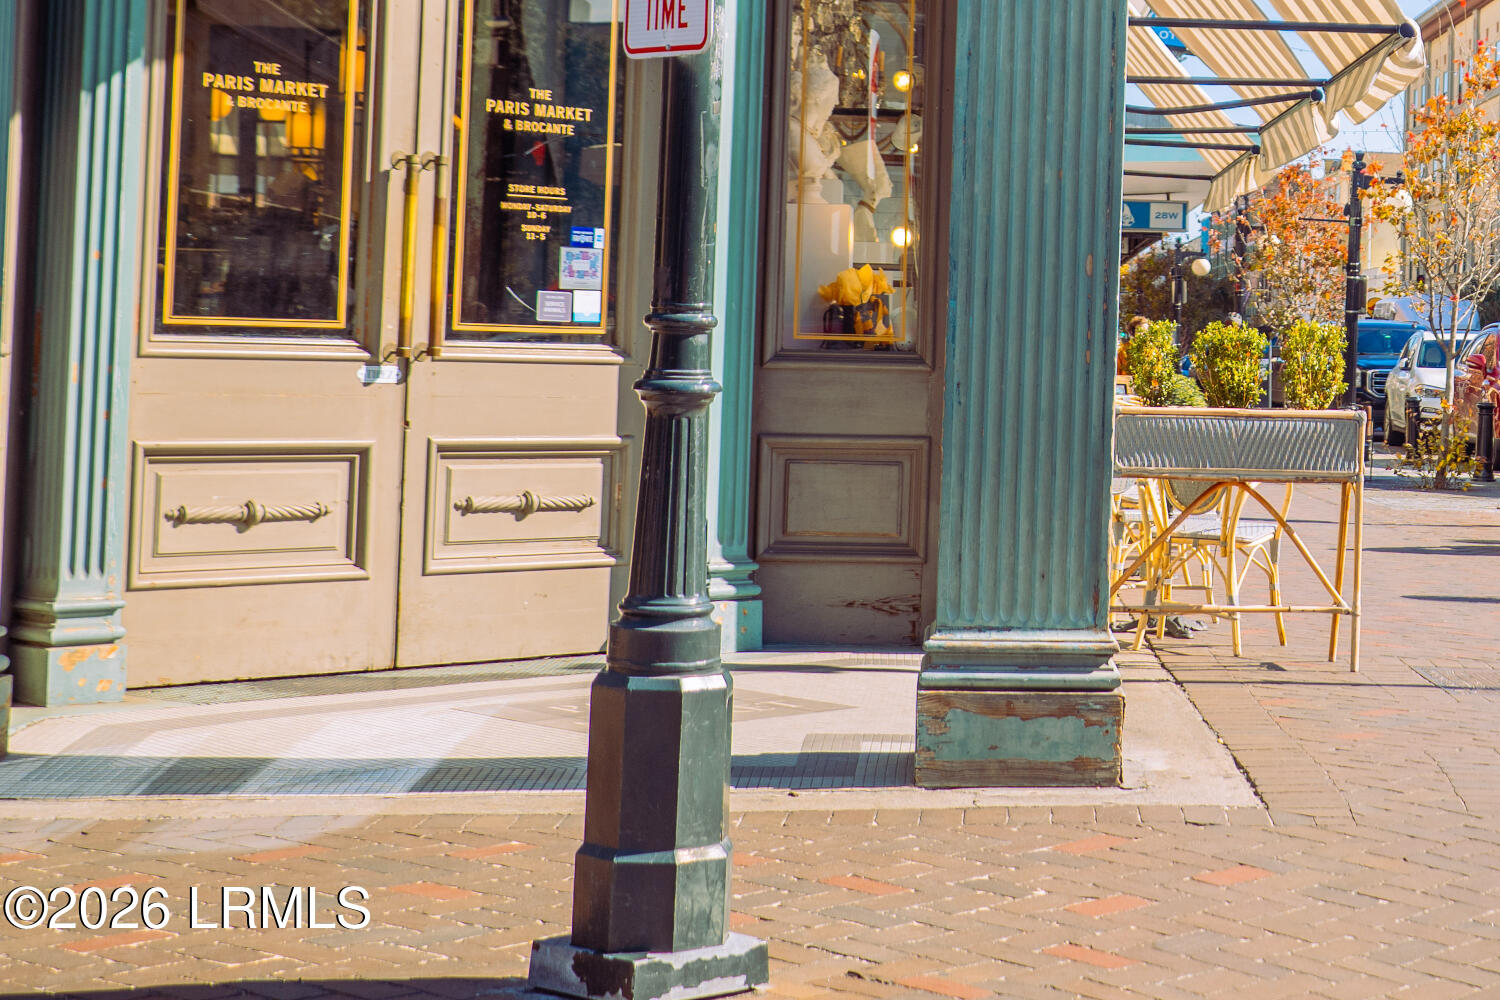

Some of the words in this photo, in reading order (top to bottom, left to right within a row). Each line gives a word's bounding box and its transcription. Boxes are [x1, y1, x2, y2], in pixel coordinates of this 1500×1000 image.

[253, 61, 281, 75] THE
[202, 72, 255, 92] PARIS
[259, 78, 329, 98] MARKET
[529, 88, 552, 101] THE
[237, 95, 308, 113] BROCANTE
[485, 98, 529, 116] PARIS
[534, 103, 593, 122] MARKET
[503, 118, 513, 131] &
[515, 120, 575, 136] BROCANTE
[508, 183, 536, 194] STORE
[1155, 211, 1178, 219] 28W
